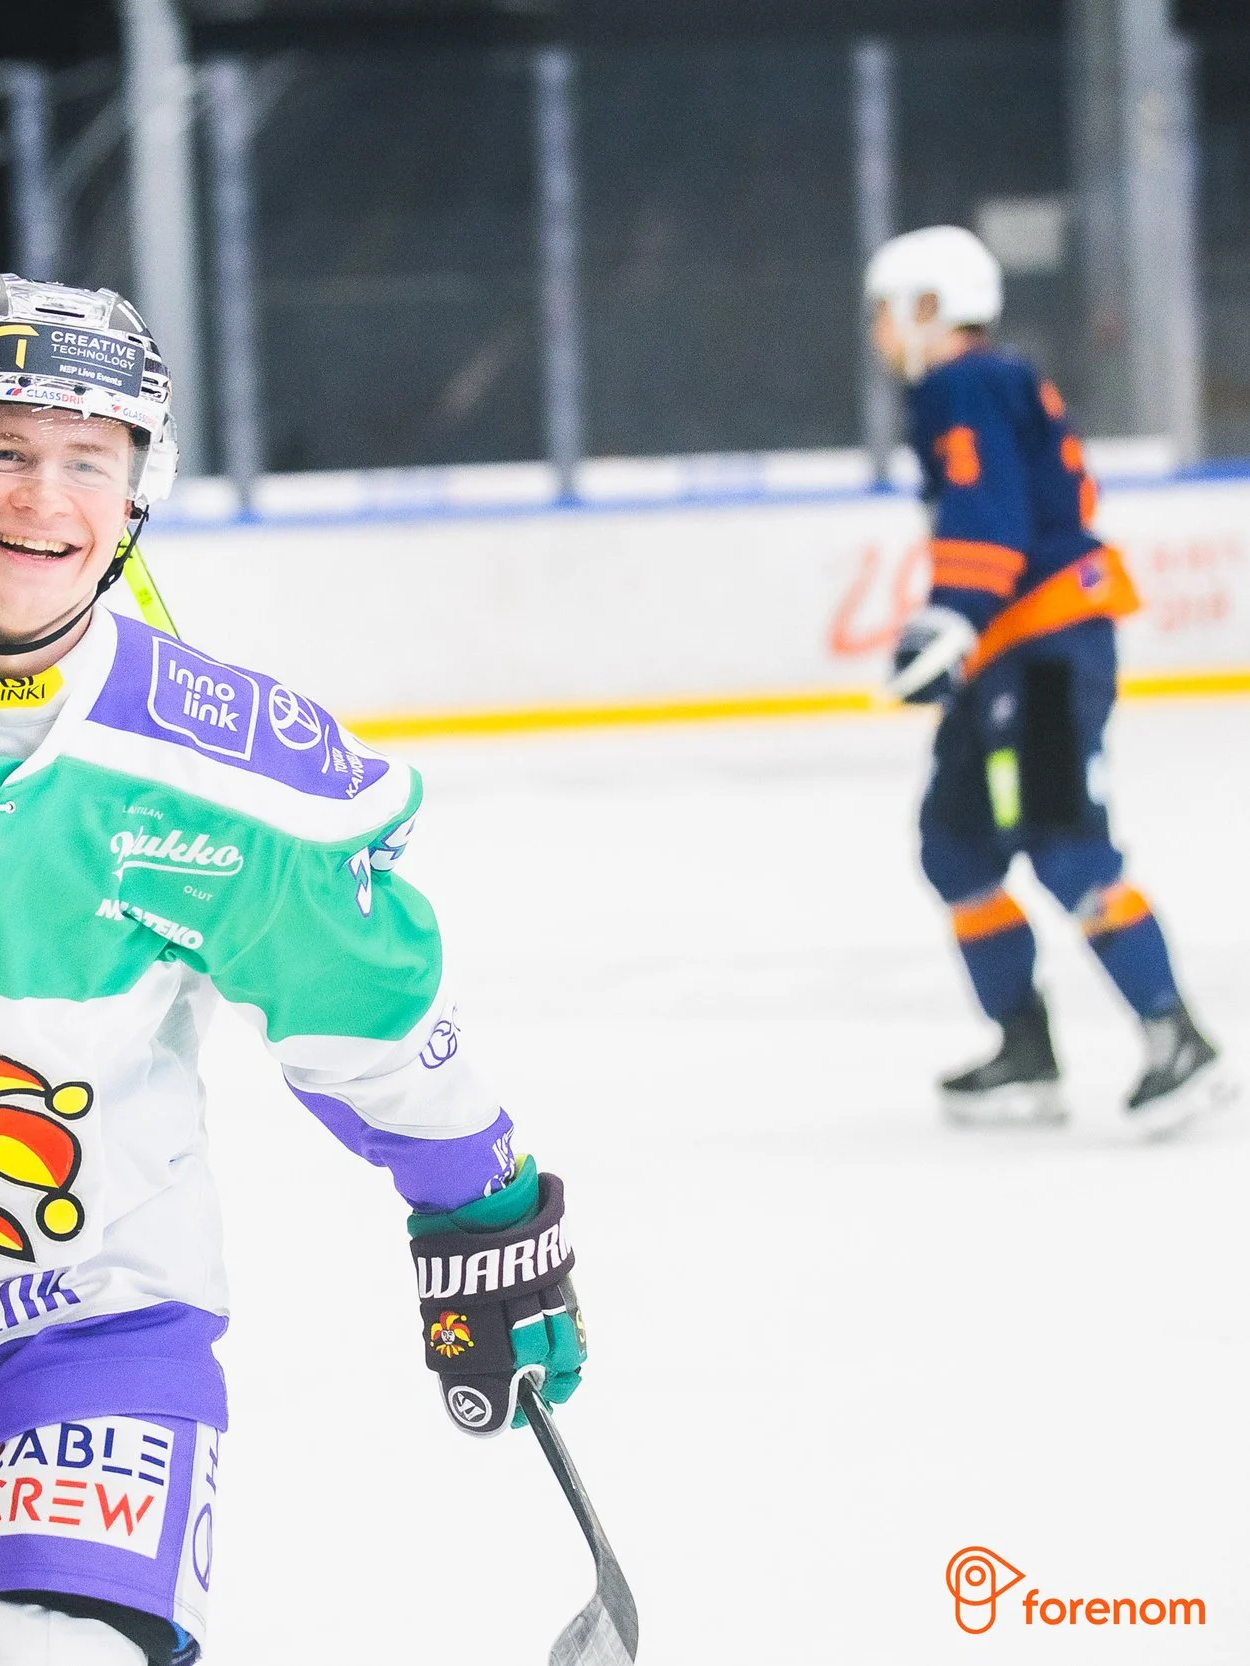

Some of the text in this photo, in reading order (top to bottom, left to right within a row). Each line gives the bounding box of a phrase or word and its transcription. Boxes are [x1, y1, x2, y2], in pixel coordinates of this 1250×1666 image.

[51, 331, 136, 361] CREATIVE
[51, 343, 135, 370] TECHNOLOGY
[59, 364, 123, 387] NEP Live Events
[168, 659, 236, 702] Inno
[183, 690, 240, 732] link
[183, 885, 214, 901] OLUT
